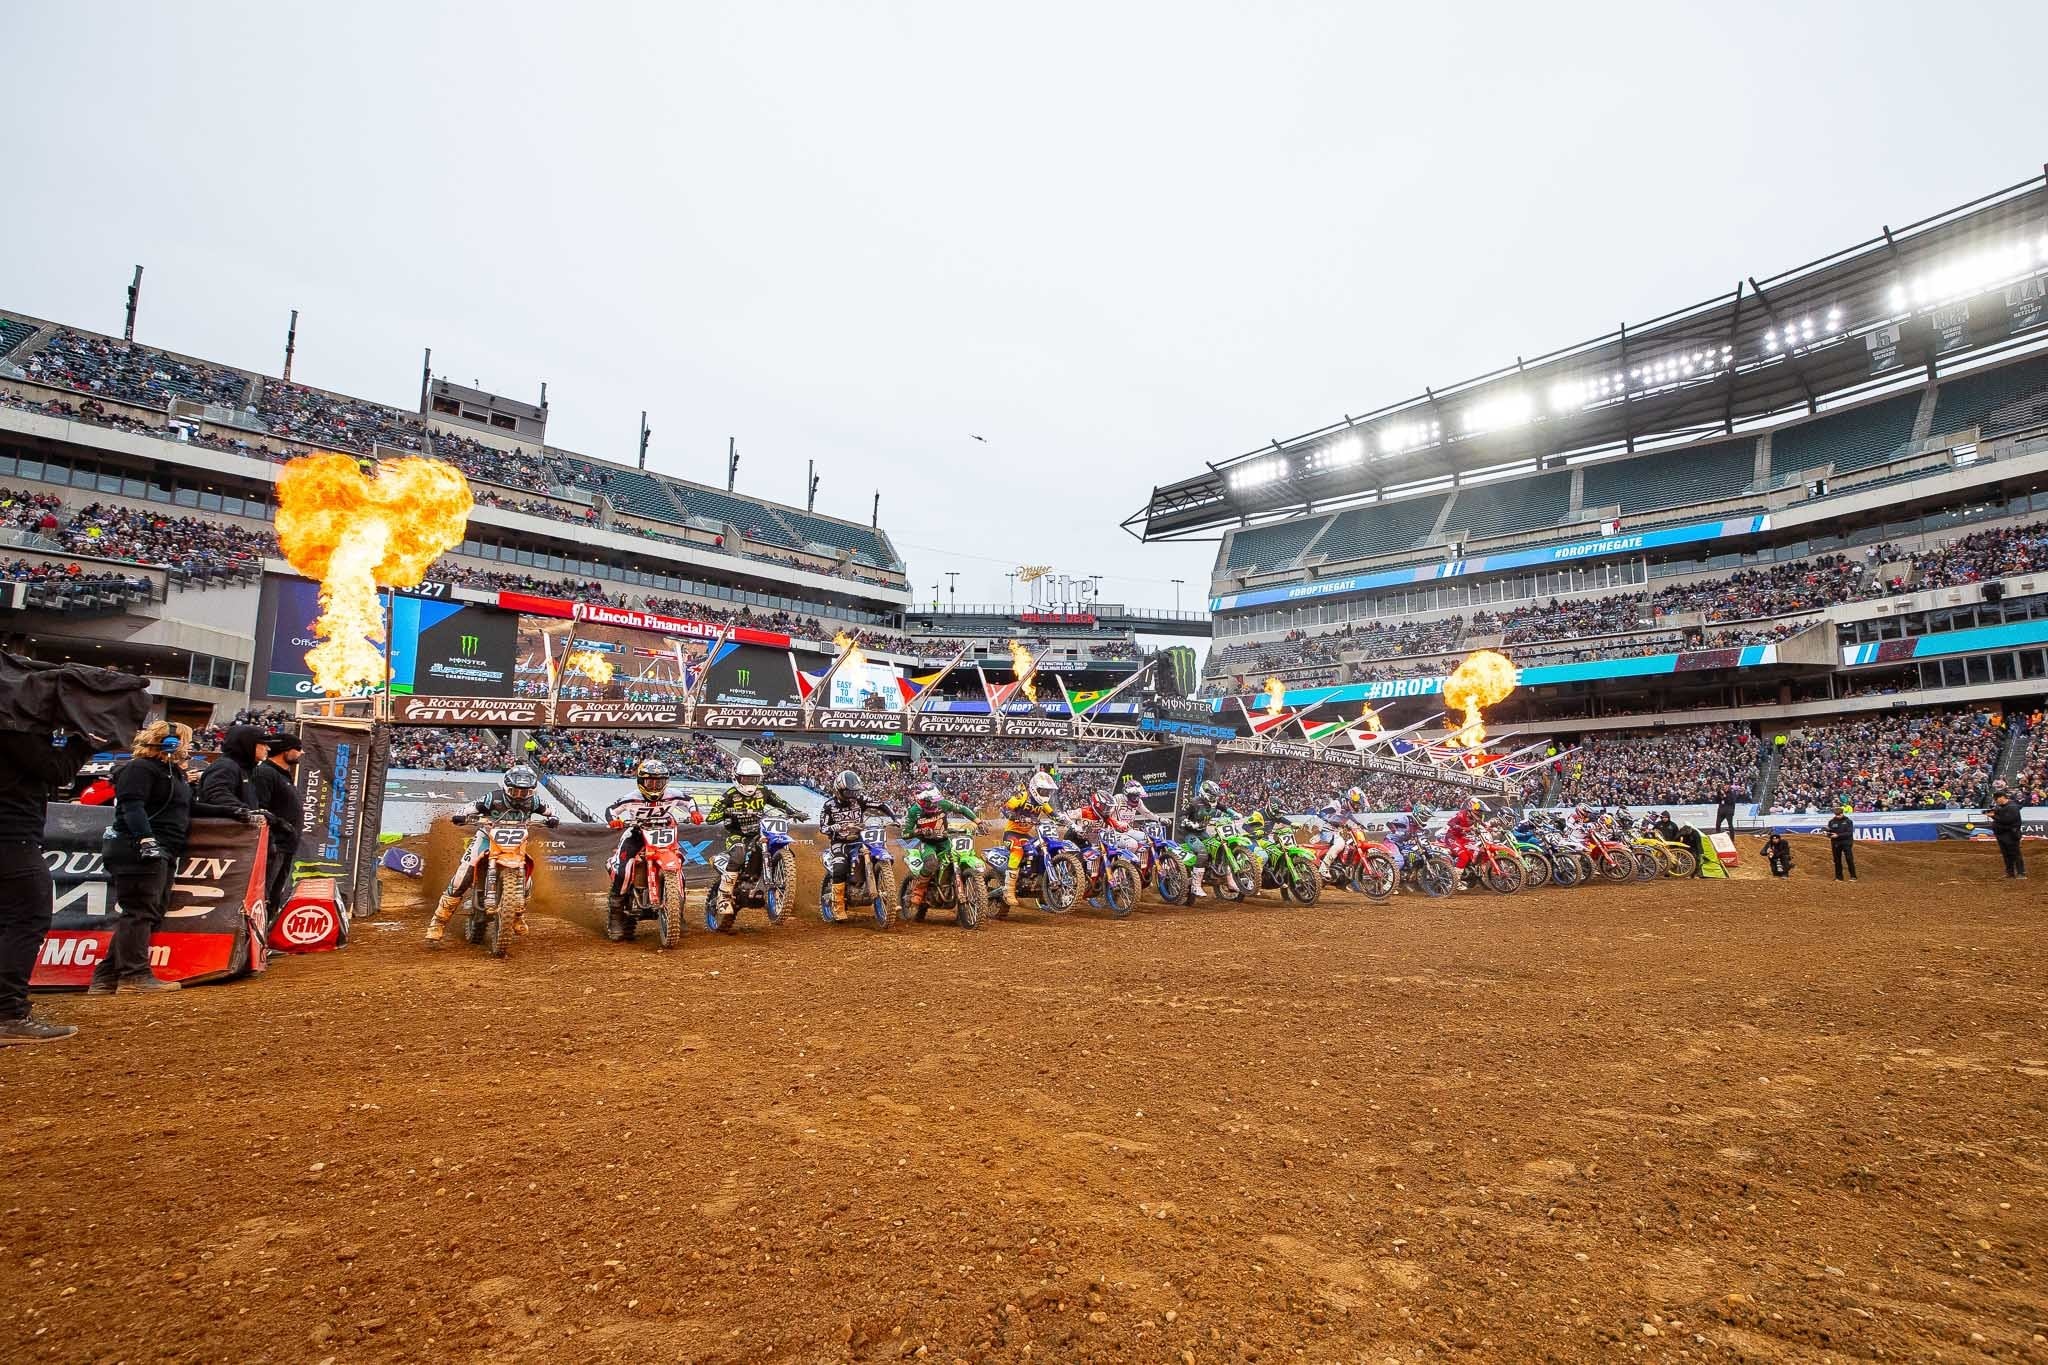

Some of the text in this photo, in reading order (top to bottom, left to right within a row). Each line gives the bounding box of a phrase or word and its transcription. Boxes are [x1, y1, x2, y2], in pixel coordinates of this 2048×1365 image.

[1875, 330, 1891, 347] 5
[1554, 536, 1643, 559] #DROPTHEGATE
[1028, 574, 1093, 613] Lite
[1288, 579, 1356, 598] #DROPTHEGATE
[589, 609, 642, 626] Lincoln
[643, 616, 703, 636] Financial
[1066, 614, 1095, 624] DECK
[836, 680, 852, 689] EASY
[882, 686, 897, 695] EASY
[840, 688, 849, 697] TO
[885, 694, 894, 702] TO
[427, 698, 536, 712] ROCKY MOUNTAIN
[586, 702, 677, 712] ROCKY MOUNTAIN
[835, 696, 854, 705] DRINK
[1161, 698, 1213, 713] MONSTER
[720, 708, 798, 717] ROCKY MOUNTAIN
[833, 711, 901, 721] ROCKY MOUNTAIN
[931, 715, 991, 725] ROCKY MOUNTAIN
[1015, 719, 1068, 729] ROCKY MOUNTAIN
[1140, 718, 1237, 740] SUPERCROSS
[302, 769, 321, 833] MONSTER
[318, 780, 328, 824] ENERGY
[326, 743, 350, 860] SUPERCROSS
[345, 768, 361, 836] CHAMPIONSHIP
[635, 806, 671, 818] FLY
[764, 819, 787, 834] 70
[494, 830, 525, 845] 62
[650, 829, 673, 845] 15
[864, 830, 887, 843] 91
[1853, 828, 1896, 841] MAHA
[318, 843, 327, 857] AMA
[956, 838, 970, 851] 81
[714, 856, 728, 865] 70
[989, 852, 1009, 865] 23
[292, 916, 325, 933] RM
